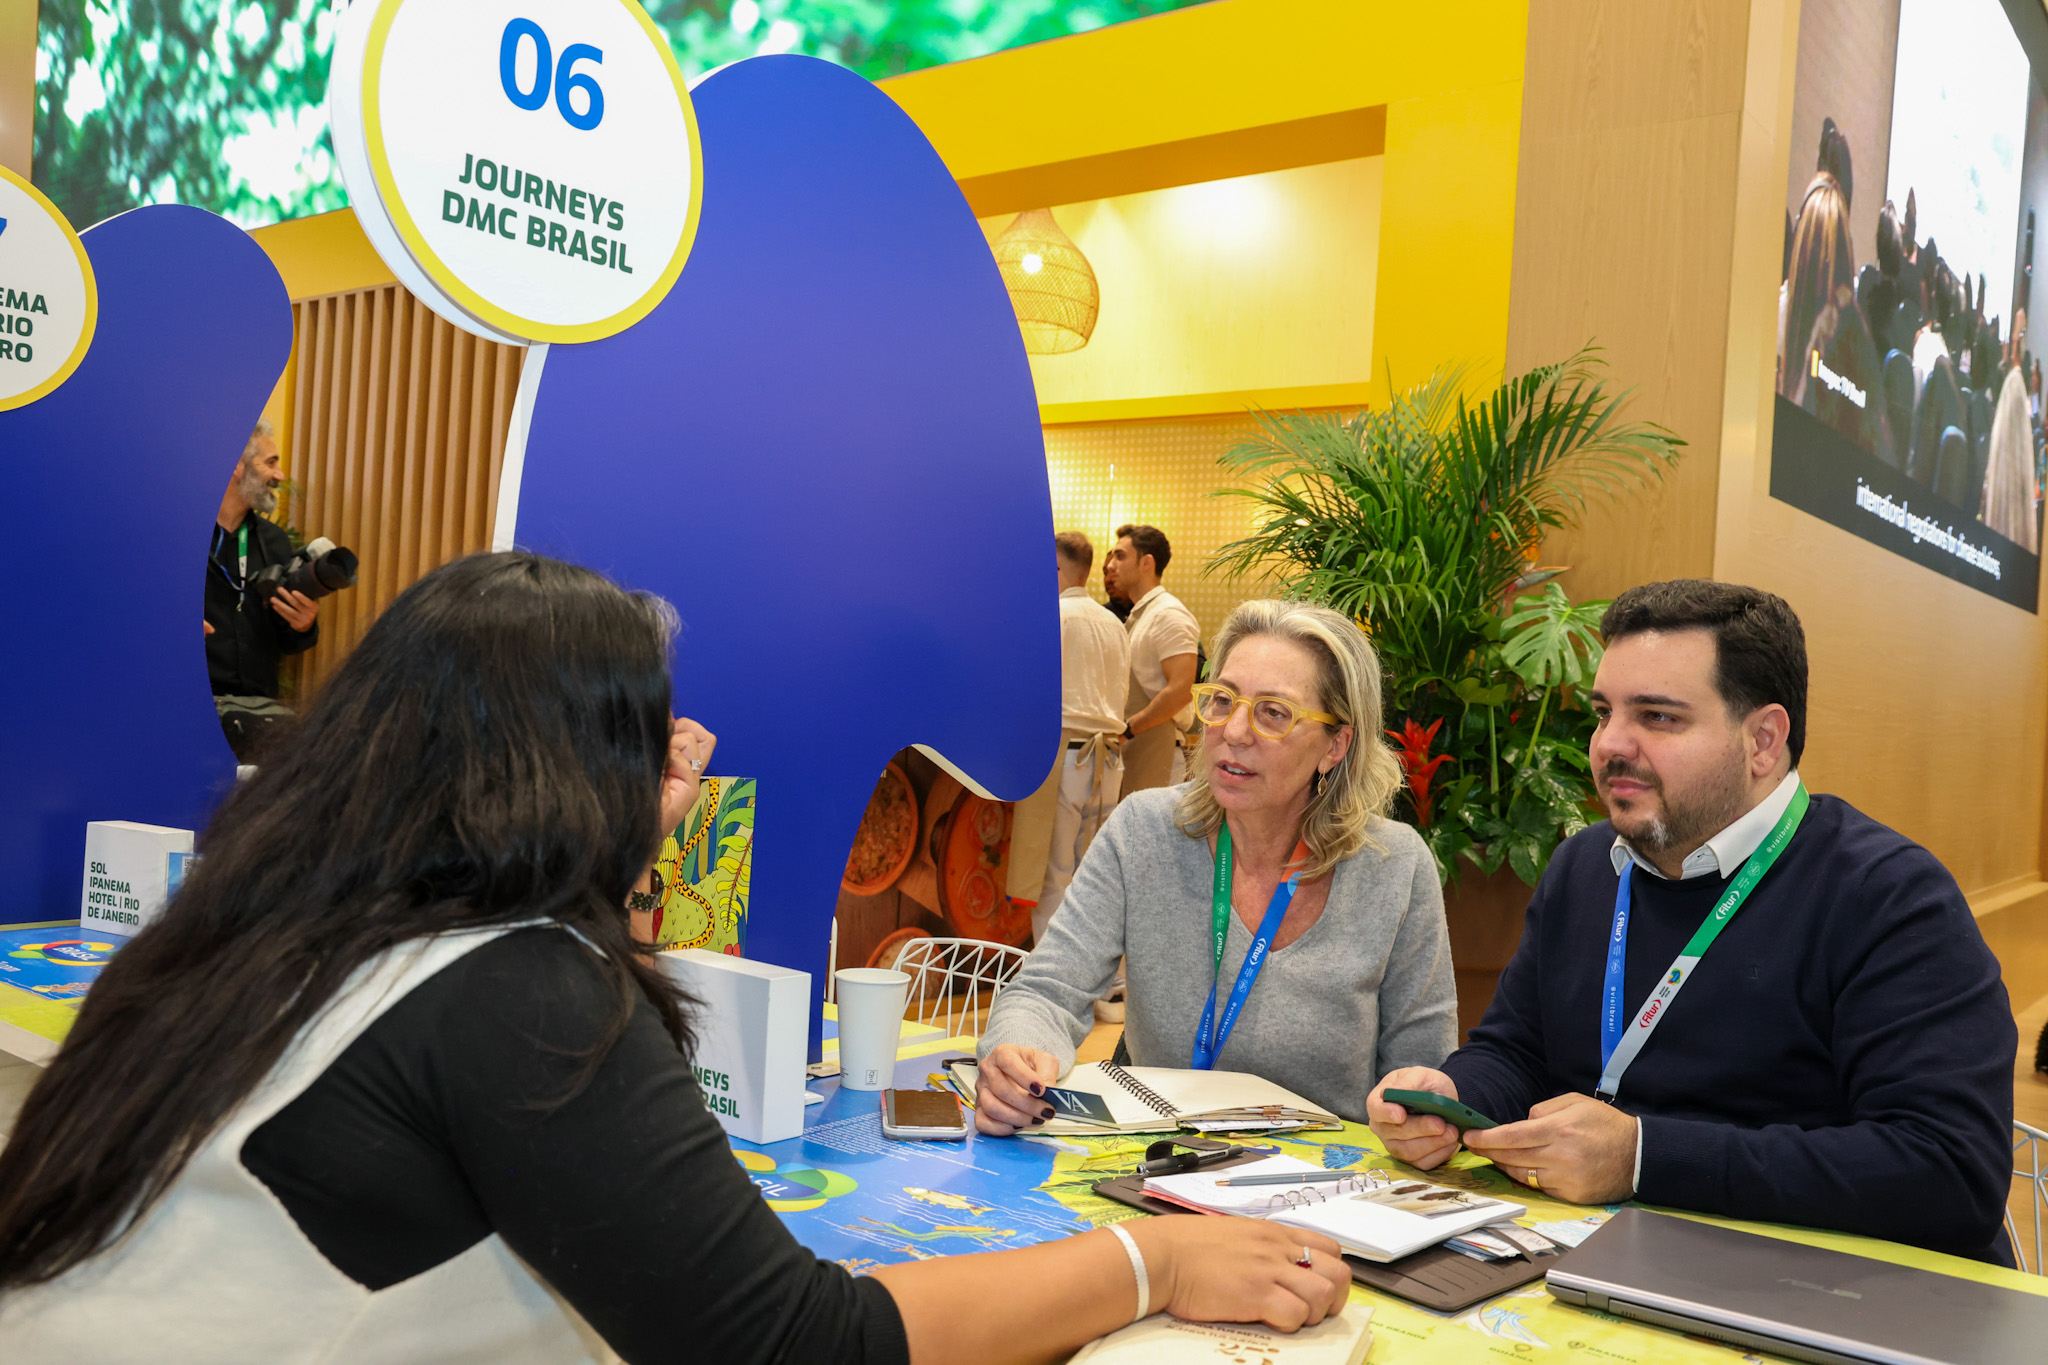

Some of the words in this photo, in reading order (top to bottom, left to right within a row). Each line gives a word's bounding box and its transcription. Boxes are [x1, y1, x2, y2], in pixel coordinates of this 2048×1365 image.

[499, 17, 605, 131] 06
[458, 153, 625, 231] JOURNEYS
[441, 189, 518, 240] DMC
[526, 214, 633, 275] BRASIL
[90, 861, 108, 875] SOL
[89, 876, 131, 894] IPANEMA
[88, 891, 118, 907] HOTEL
[124, 896, 140, 911] RIO
[87, 906, 100, 918] DE
[101, 908, 140, 926] JANEIRO
[1049, 1089, 1094, 1115] VA
